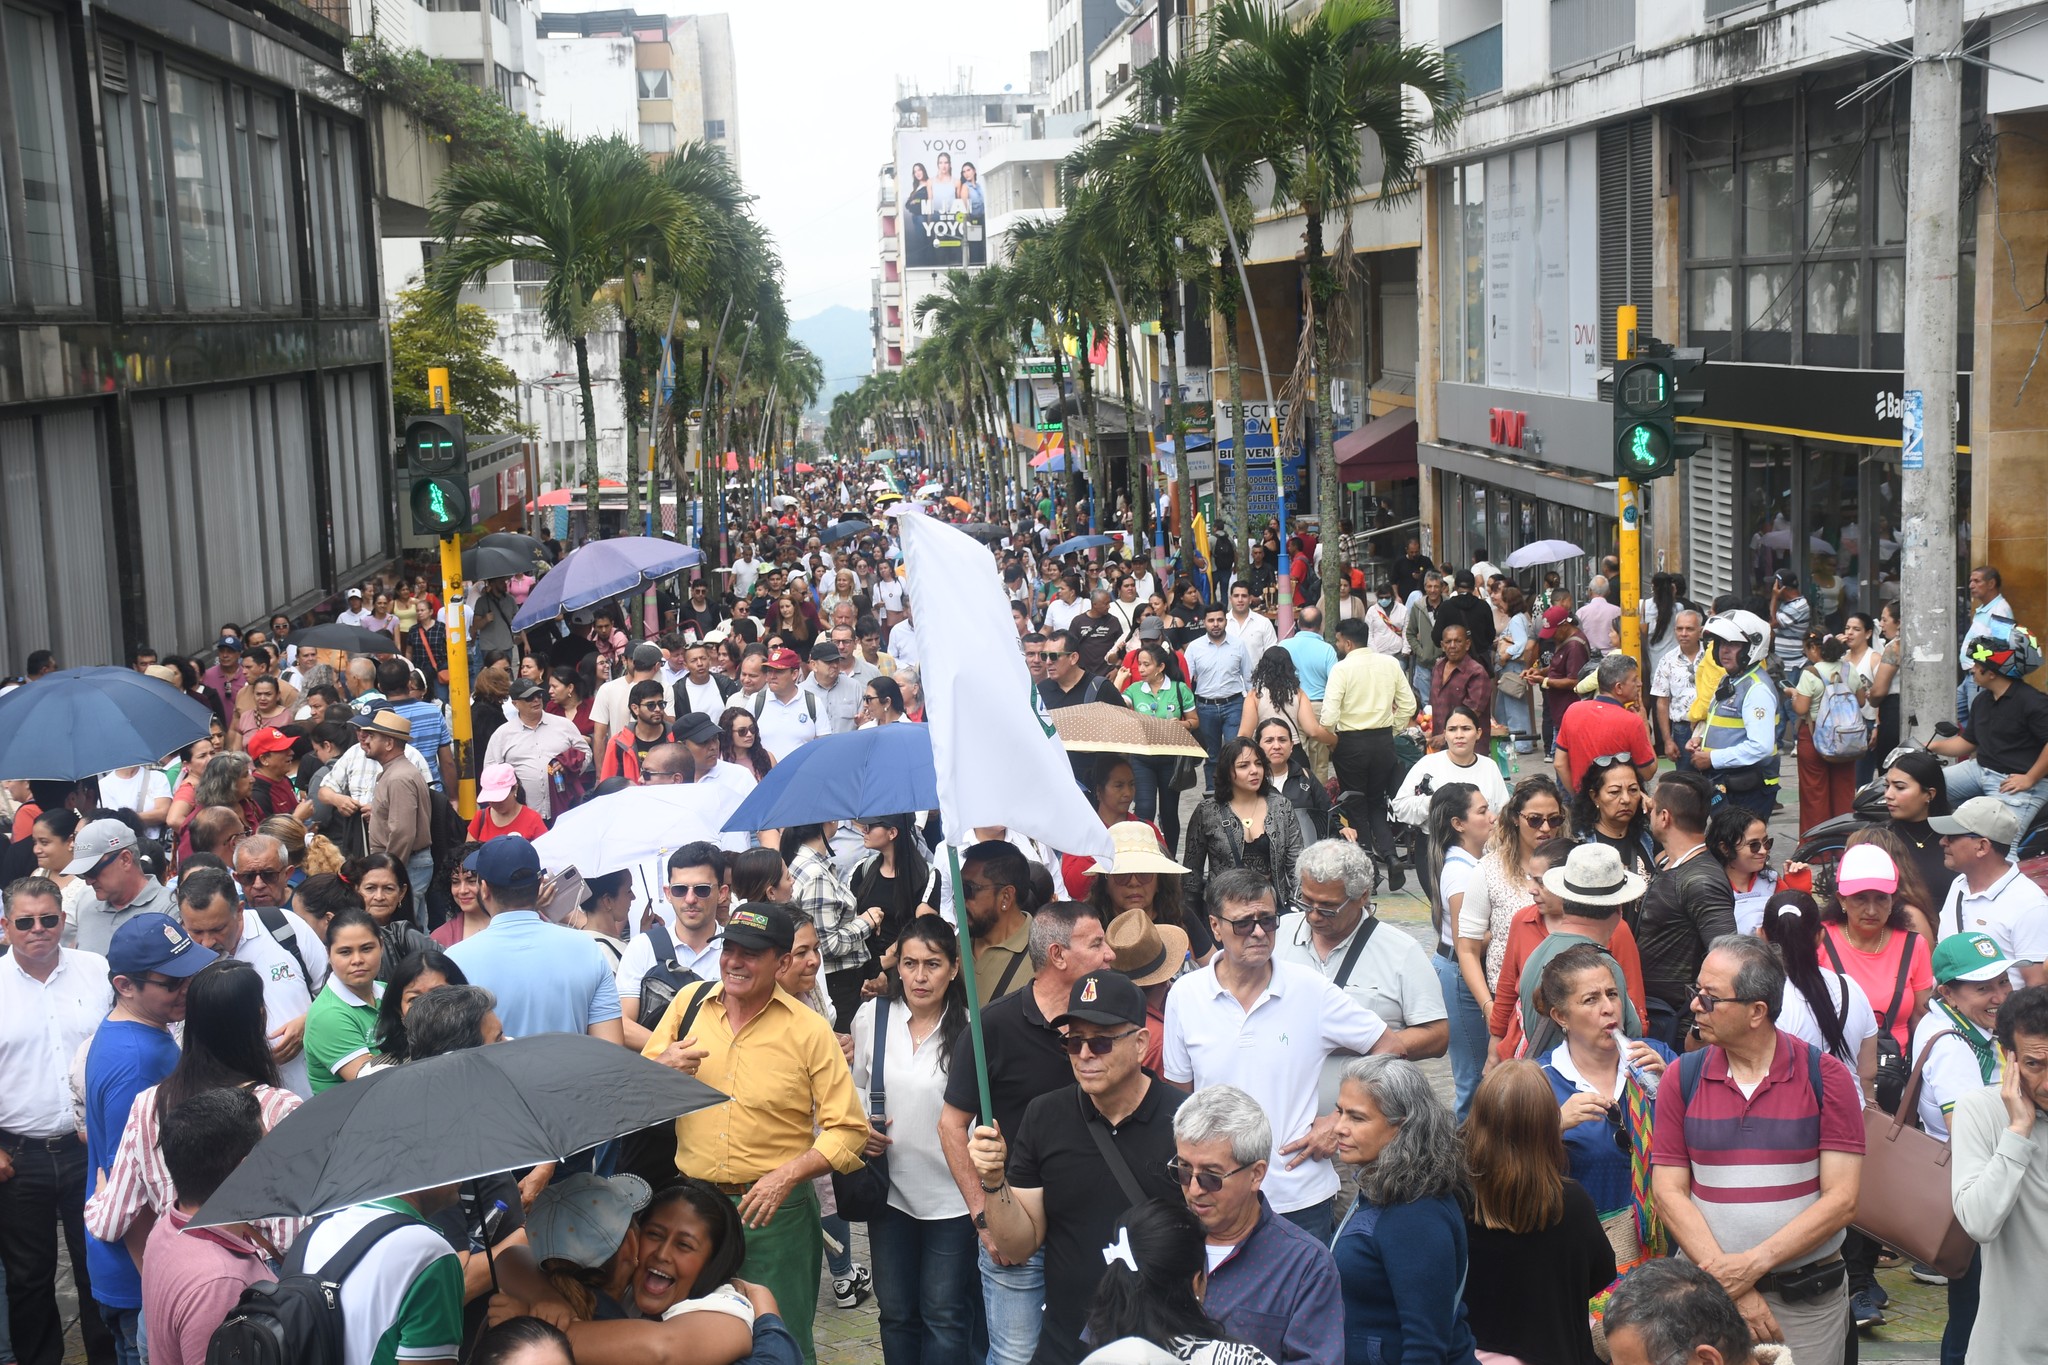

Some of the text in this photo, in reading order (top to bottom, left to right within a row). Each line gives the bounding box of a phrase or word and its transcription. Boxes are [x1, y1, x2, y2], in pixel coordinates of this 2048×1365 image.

[923, 139, 966, 151] YOYO
[1226, 403, 1290, 419] EECTO
[1220, 447, 1300, 460] BIVENS
[1225, 474, 1295, 486] ELODOMÉSCOS
